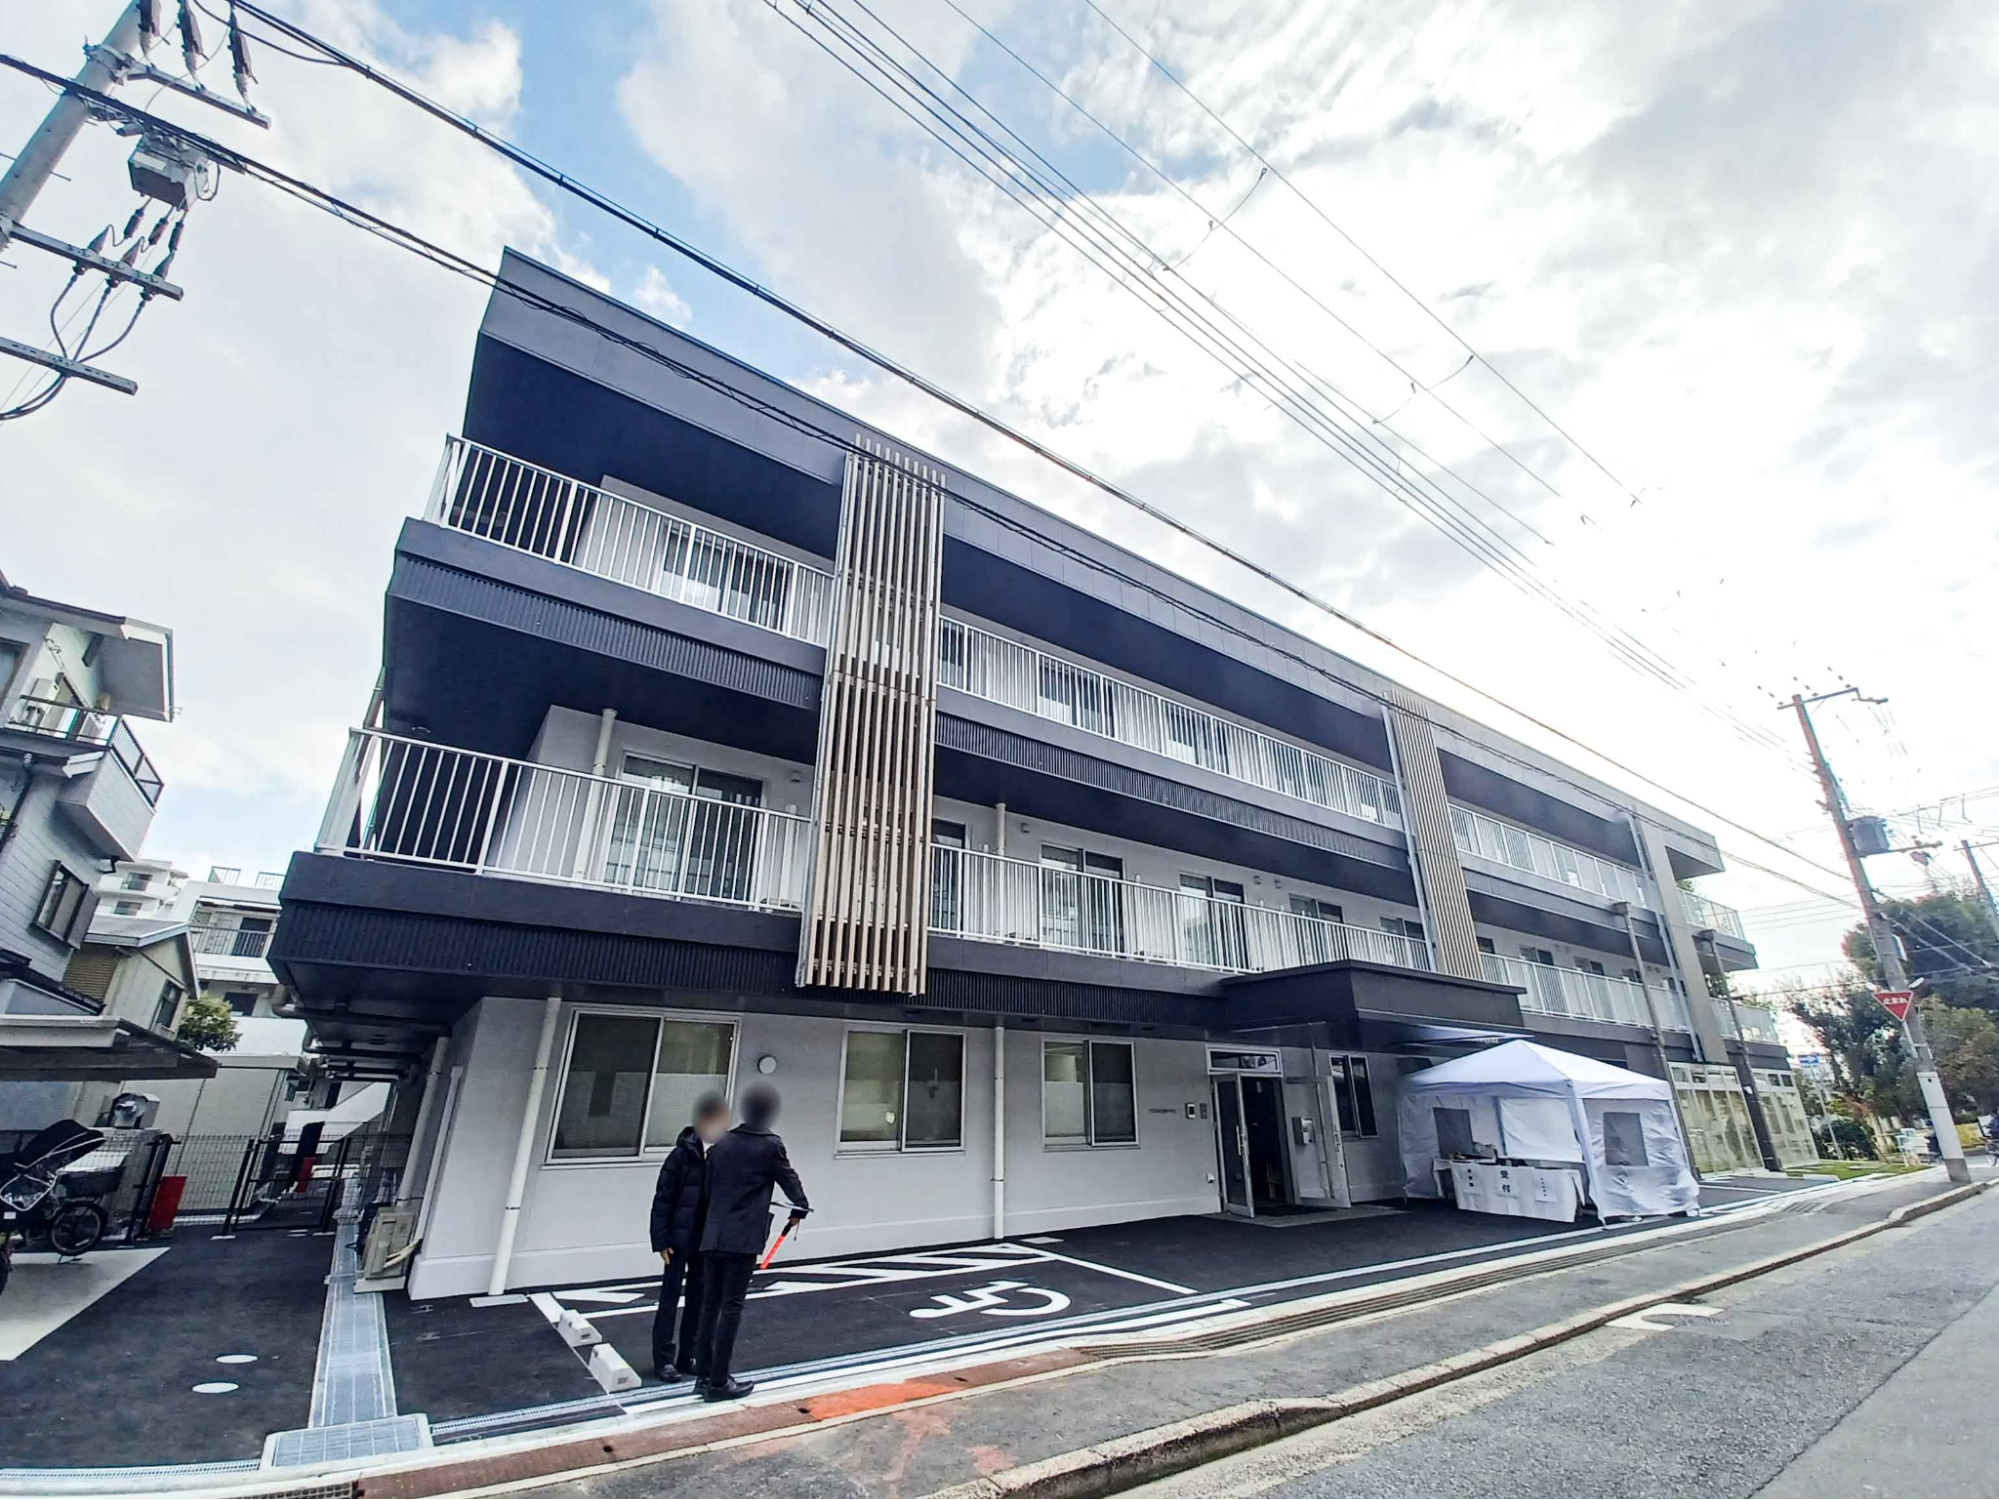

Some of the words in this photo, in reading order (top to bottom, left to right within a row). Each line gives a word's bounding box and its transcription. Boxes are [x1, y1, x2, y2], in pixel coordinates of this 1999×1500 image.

[1883, 997, 1908, 1005] 止まれ
[1500, 1170, 1511, 1193] 受付
